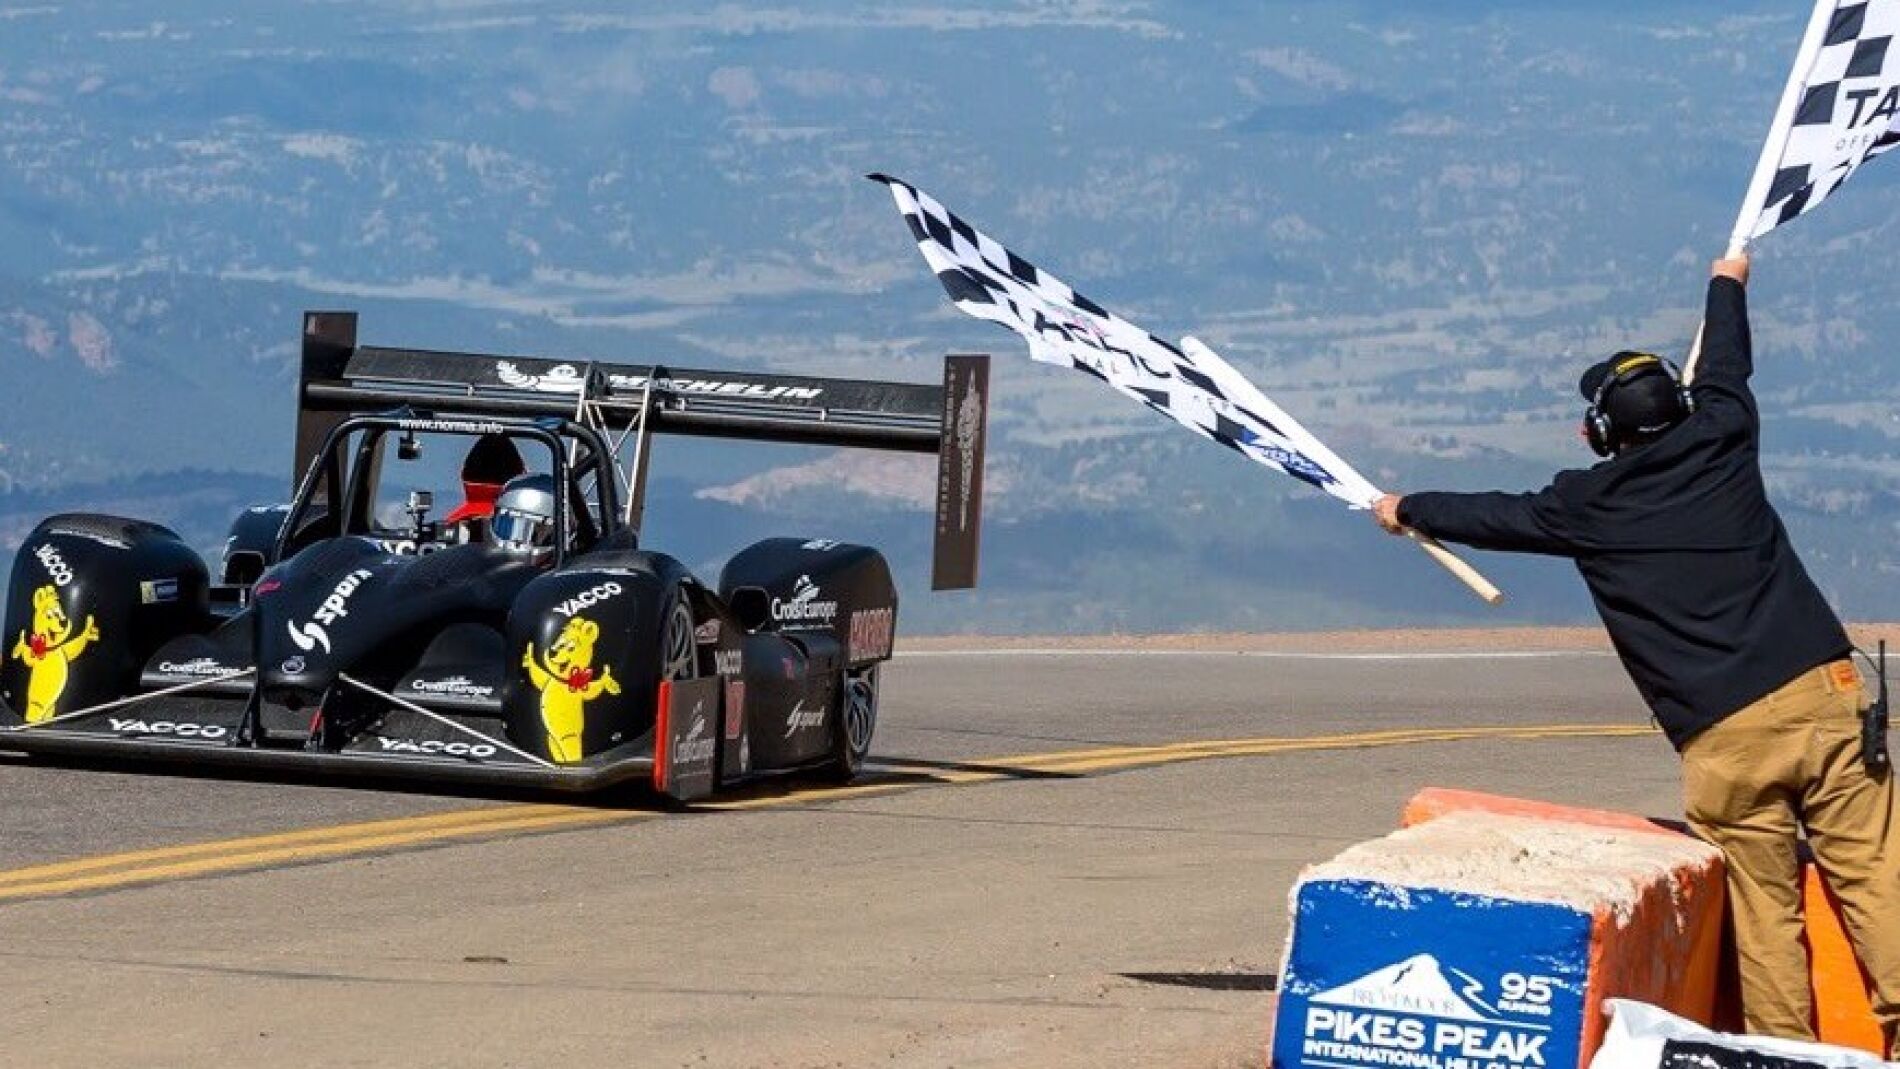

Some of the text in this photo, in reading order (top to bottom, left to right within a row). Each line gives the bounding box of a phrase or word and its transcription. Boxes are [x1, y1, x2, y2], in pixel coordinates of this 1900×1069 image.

[606, 374, 824, 400] MCHELIN
[552, 580, 622, 617] YACCO
[108, 717, 227, 738] YACCO
[378, 735, 497, 758] YACCO
[1305, 1006, 1548, 1066] PIKES PEAK
[1302, 1039, 1439, 1069] INTERNATIONAL
